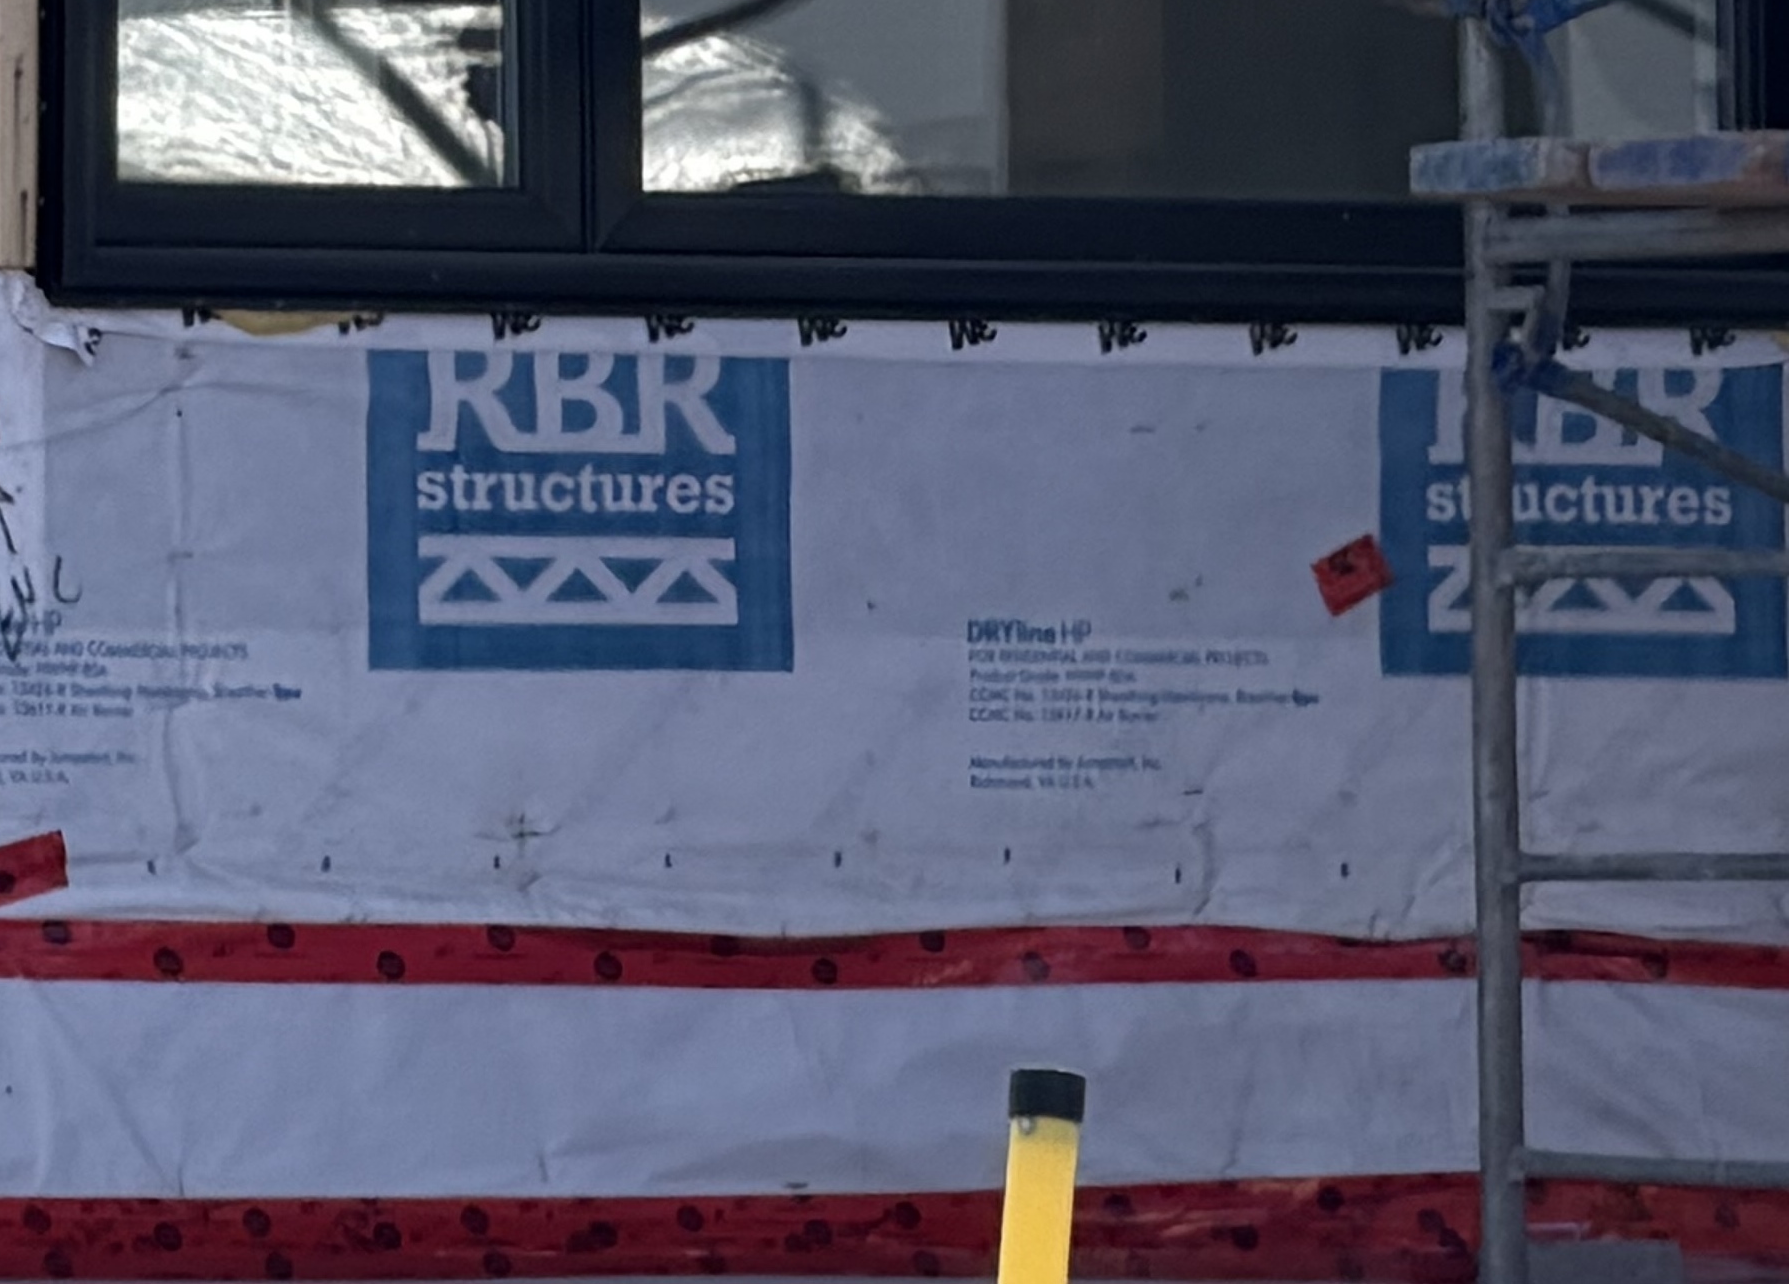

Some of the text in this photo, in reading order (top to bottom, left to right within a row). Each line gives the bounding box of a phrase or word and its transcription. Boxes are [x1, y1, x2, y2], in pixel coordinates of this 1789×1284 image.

[416, 350, 736, 455] RBR
[416, 465, 735, 513] structures
[1426, 476, 1732, 525] suctures
